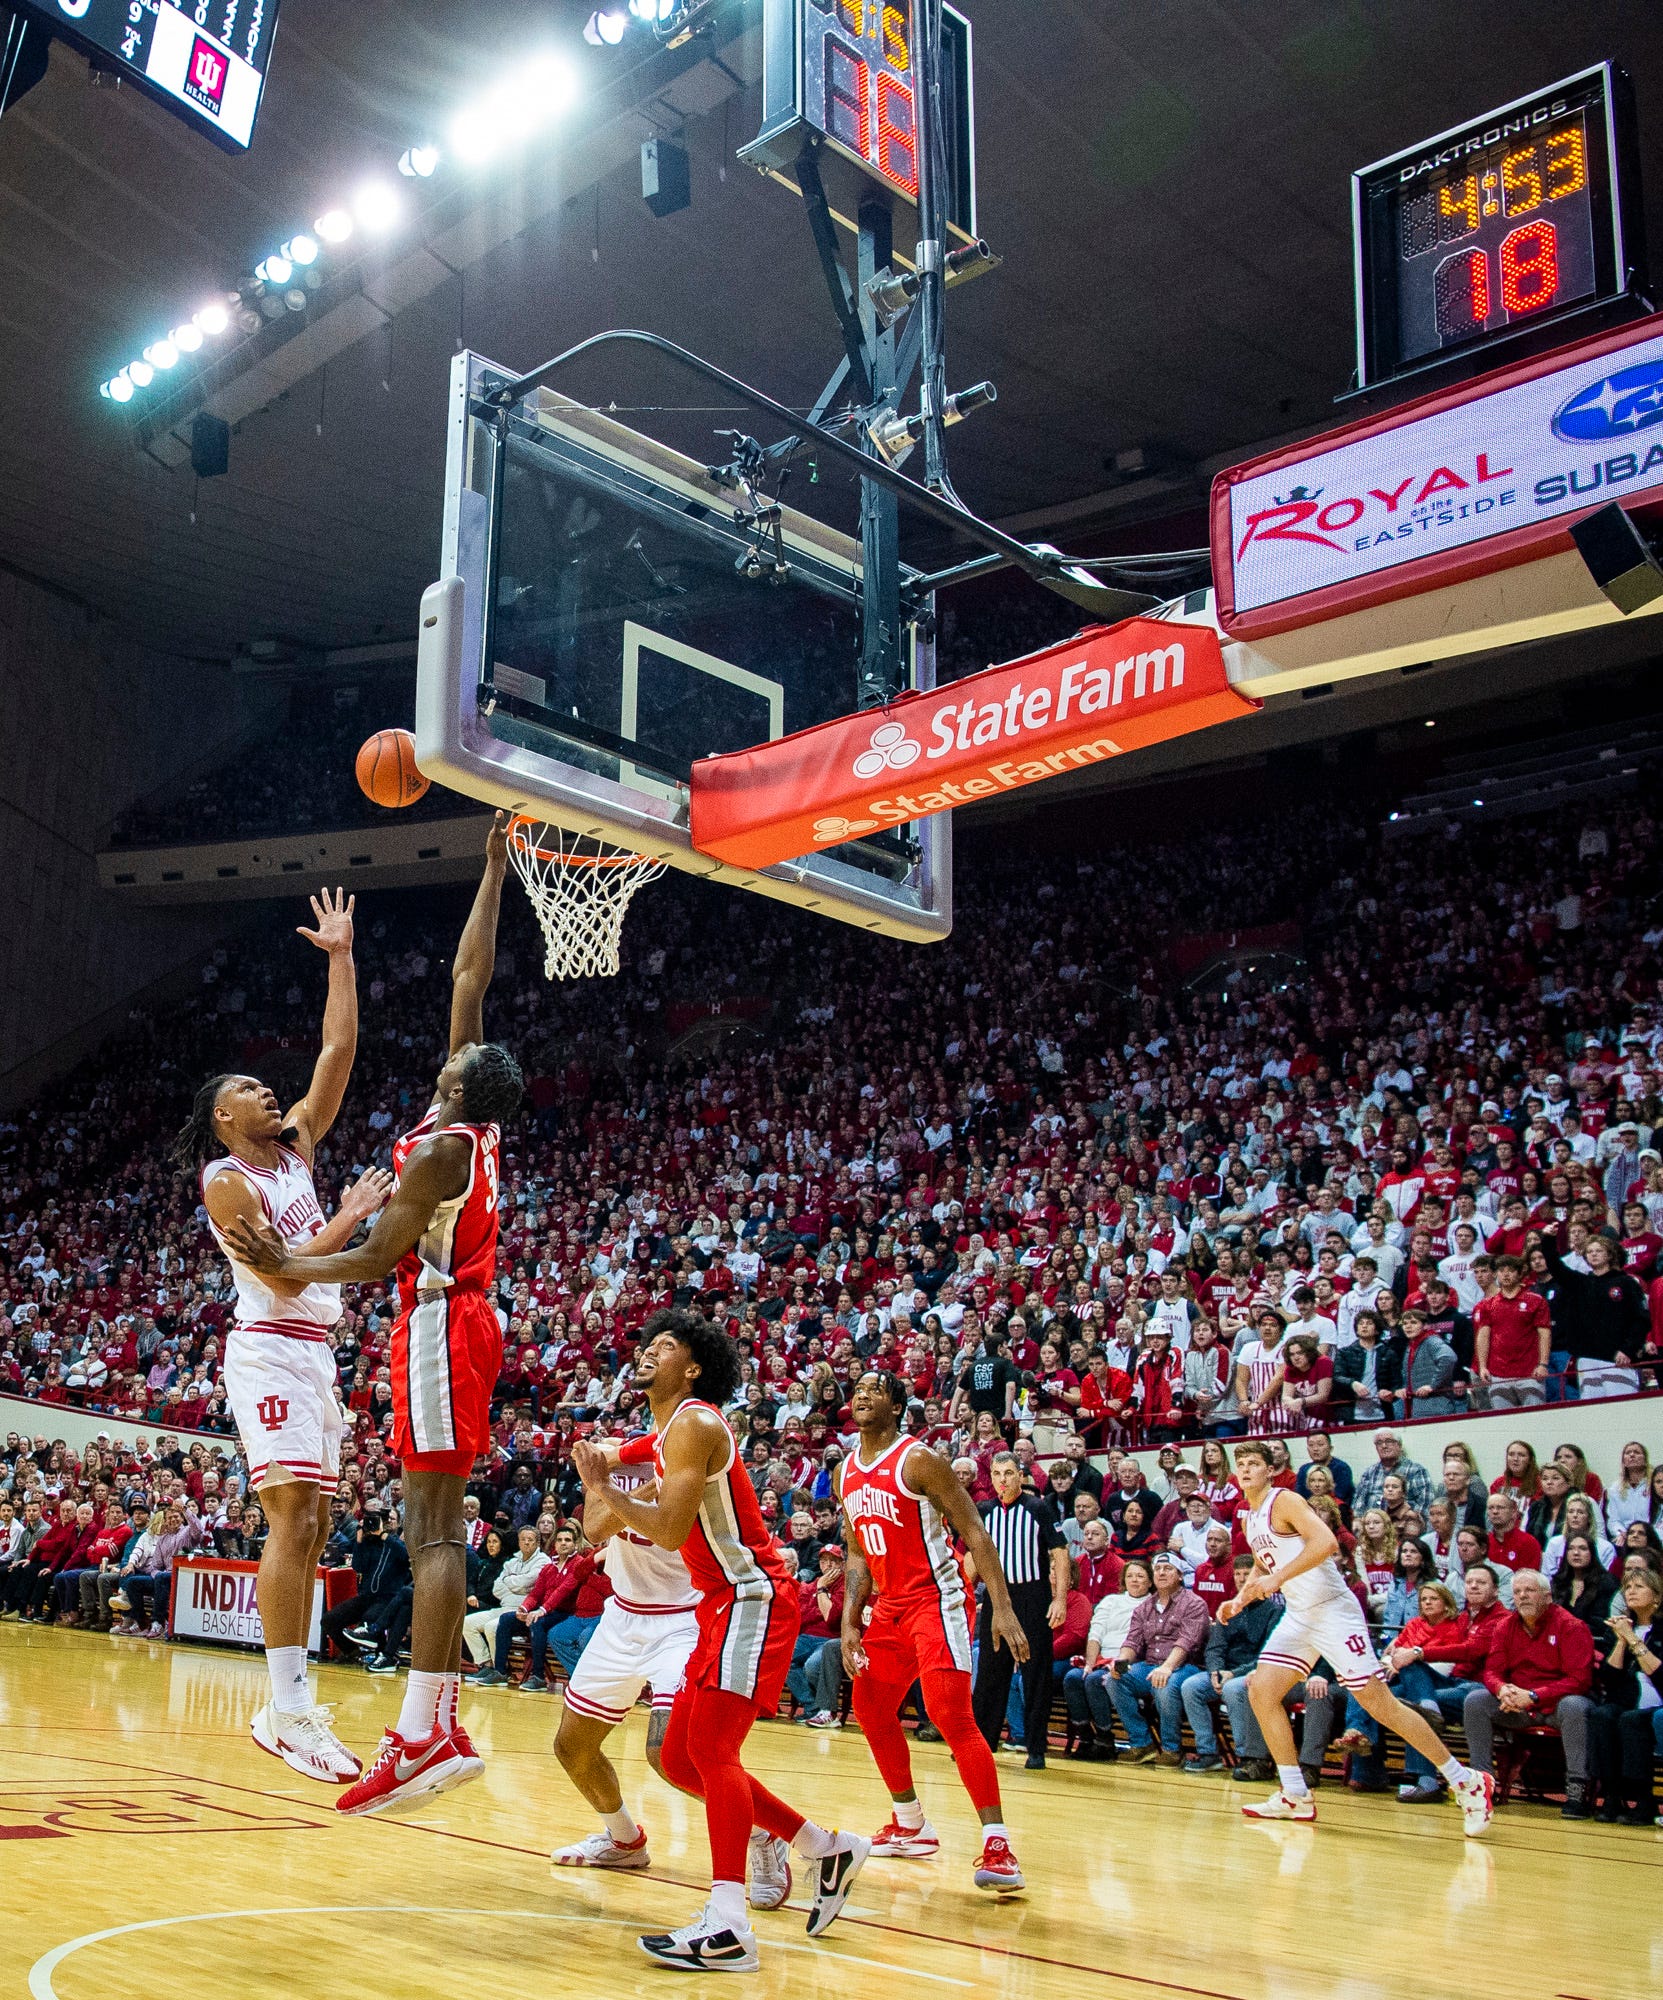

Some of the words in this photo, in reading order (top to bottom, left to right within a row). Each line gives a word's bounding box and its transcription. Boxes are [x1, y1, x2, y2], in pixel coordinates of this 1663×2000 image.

[129, 2, 142, 22] 9
[125, 25, 142, 45] TOL
[195, 6, 206, 25] 0
[220, 25, 233, 46] 2
[121, 39, 134, 59] 4
[186, 83, 220, 113] HEALTH
[1399, 99, 1568, 183] DAKTRONICS
[1440, 128, 1586, 229] 4:53
[1471, 218, 1558, 321] 18
[1237, 452, 1514, 563] ROYAL
[1431, 498, 1454, 511] the
[1355, 489, 1517, 551] EASTSIDE
[711, 1003, 721, 1014] H
[281, 1037, 289, 1048] G
[974, 1372, 993, 1381] EVENT
[975, 1363, 994, 1372] CSC
[975, 1381, 994, 1390] STAFF
[859, 1523, 887, 1556] 10
